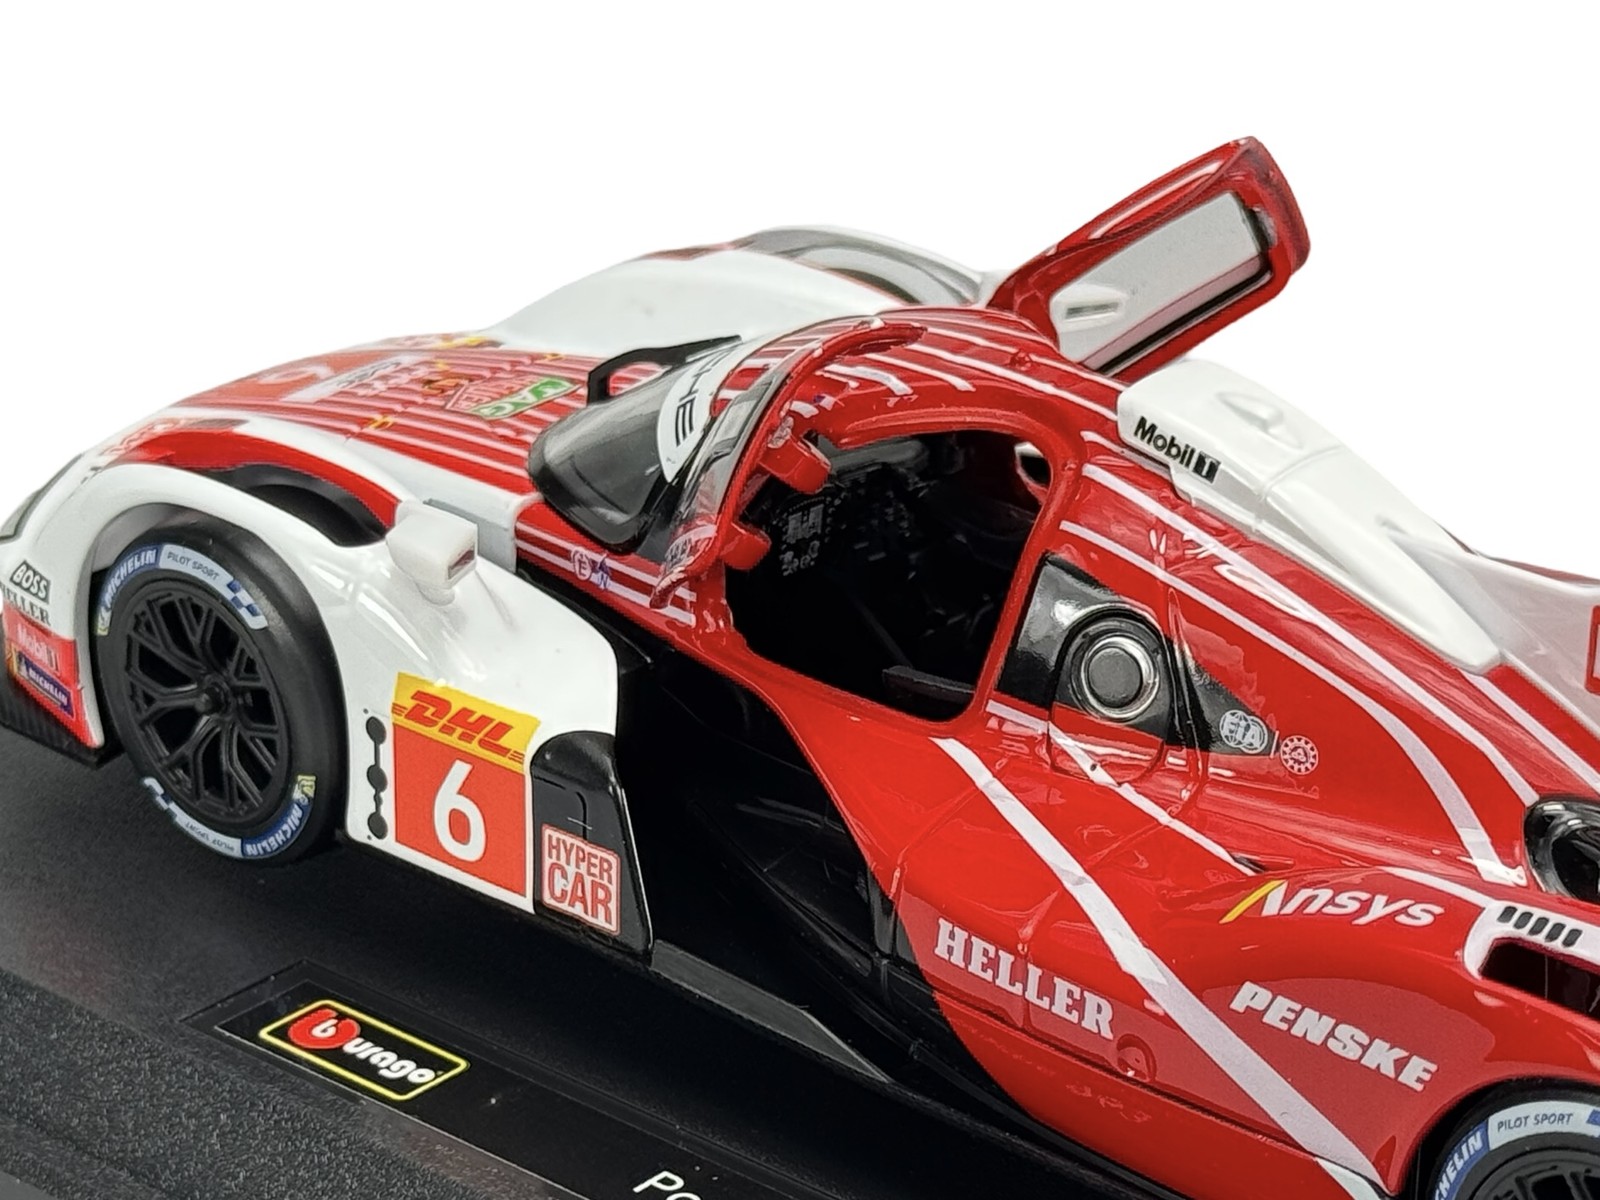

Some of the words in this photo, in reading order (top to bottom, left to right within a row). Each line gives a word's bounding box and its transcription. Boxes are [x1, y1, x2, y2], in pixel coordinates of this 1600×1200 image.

[1133, 416, 1196, 468] Mobil
[12, 564, 48, 599] BOSS
[104, 549, 157, 609] MICHELIN
[167, 551, 191, 567] PILOT
[191, 560, 219, 581] SPORT
[403, 690, 513, 757] DHL
[245, 803, 303, 856] MICHELIN
[433, 759, 487, 862] 6
[548, 834, 613, 885] HYPER
[549, 862, 613, 925] CAR
[1219, 879, 1445, 927] Ansys
[934, 917, 1114, 1040] HELLER
[1229, 981, 1439, 1093] PENSKE
[1497, 1115, 1530, 1132] PILOT
[1533, 1112, 1574, 1126] SPORT
